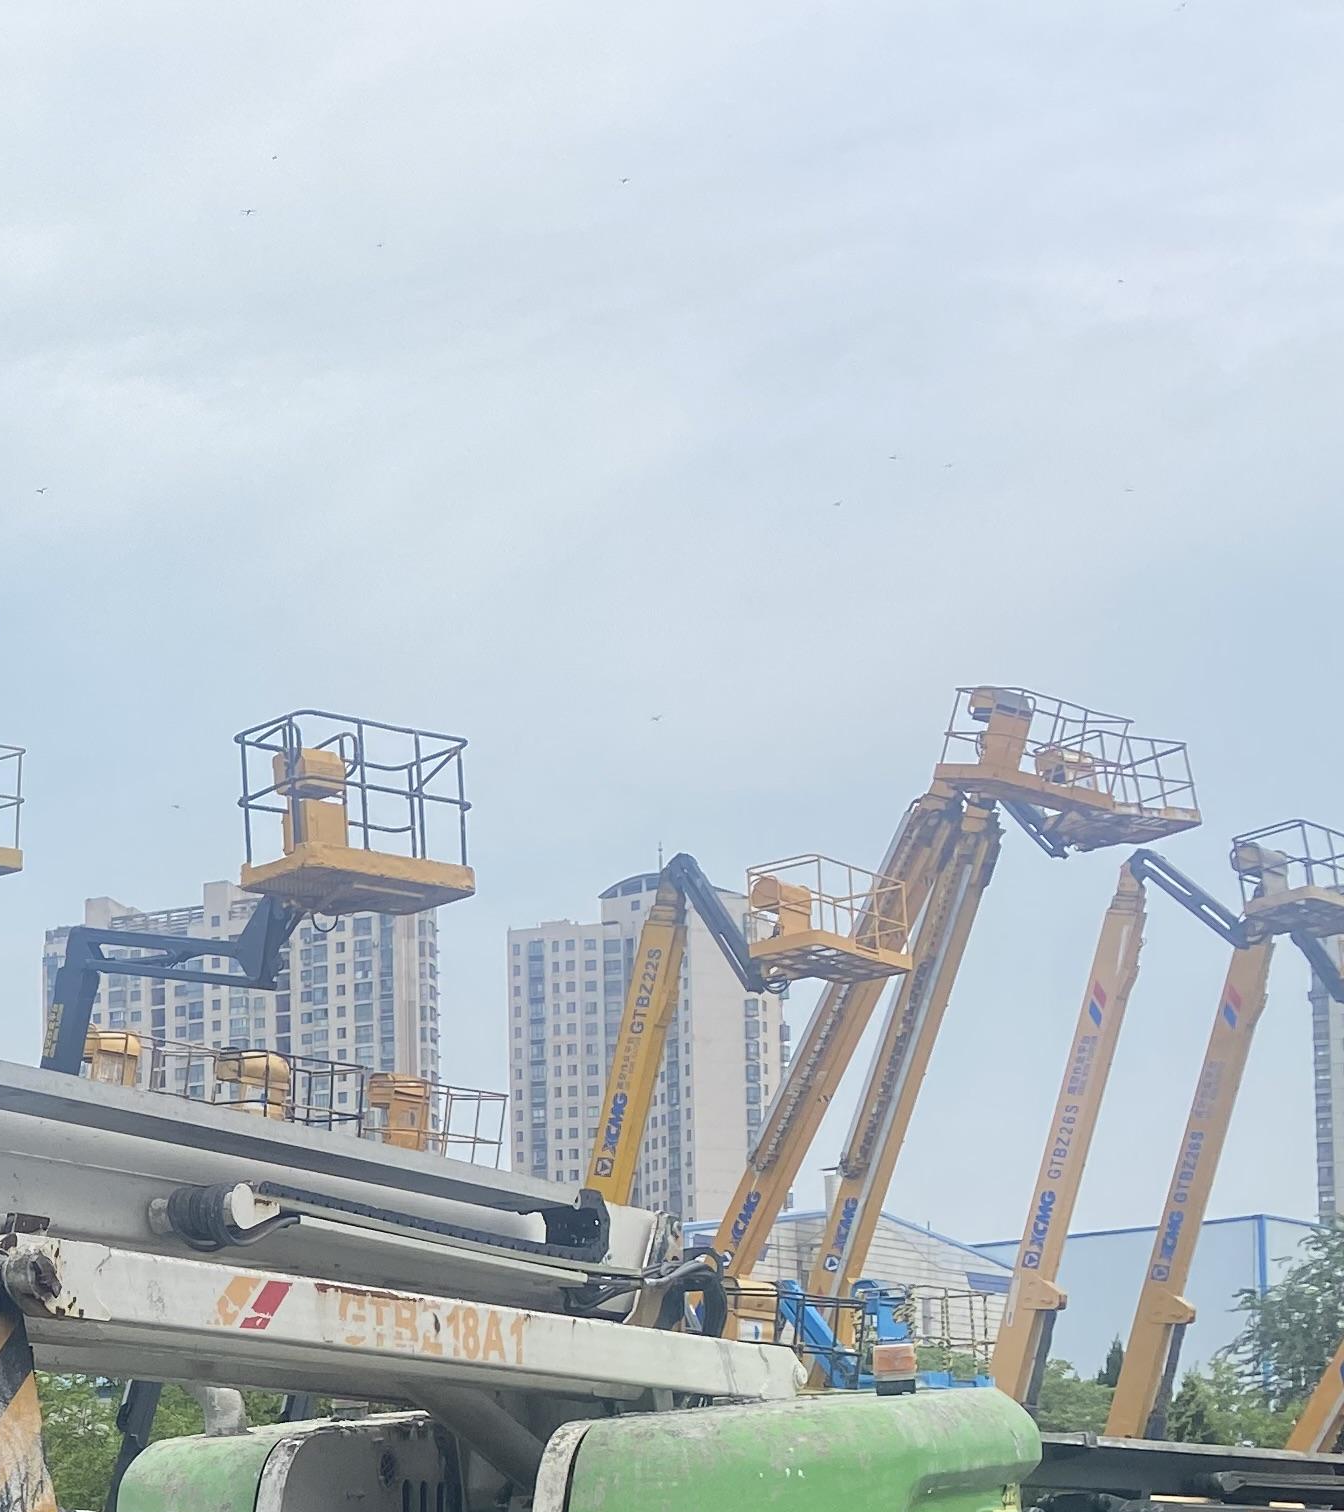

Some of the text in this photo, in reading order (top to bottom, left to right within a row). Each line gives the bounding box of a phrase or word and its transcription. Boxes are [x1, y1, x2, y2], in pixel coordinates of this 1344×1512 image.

[630, 948, 662, 1035] GTBZ22S
[602, 1091, 628, 1160] XCMG
[1047, 1104, 1079, 1180] GTBZ26S
[1173, 1131, 1204, 1203] GTBZ26S
[729, 1191, 762, 1249] XCMG
[1029, 1190, 1056, 1250] XCMG
[1160, 1210, 1185, 1262] XCMG
